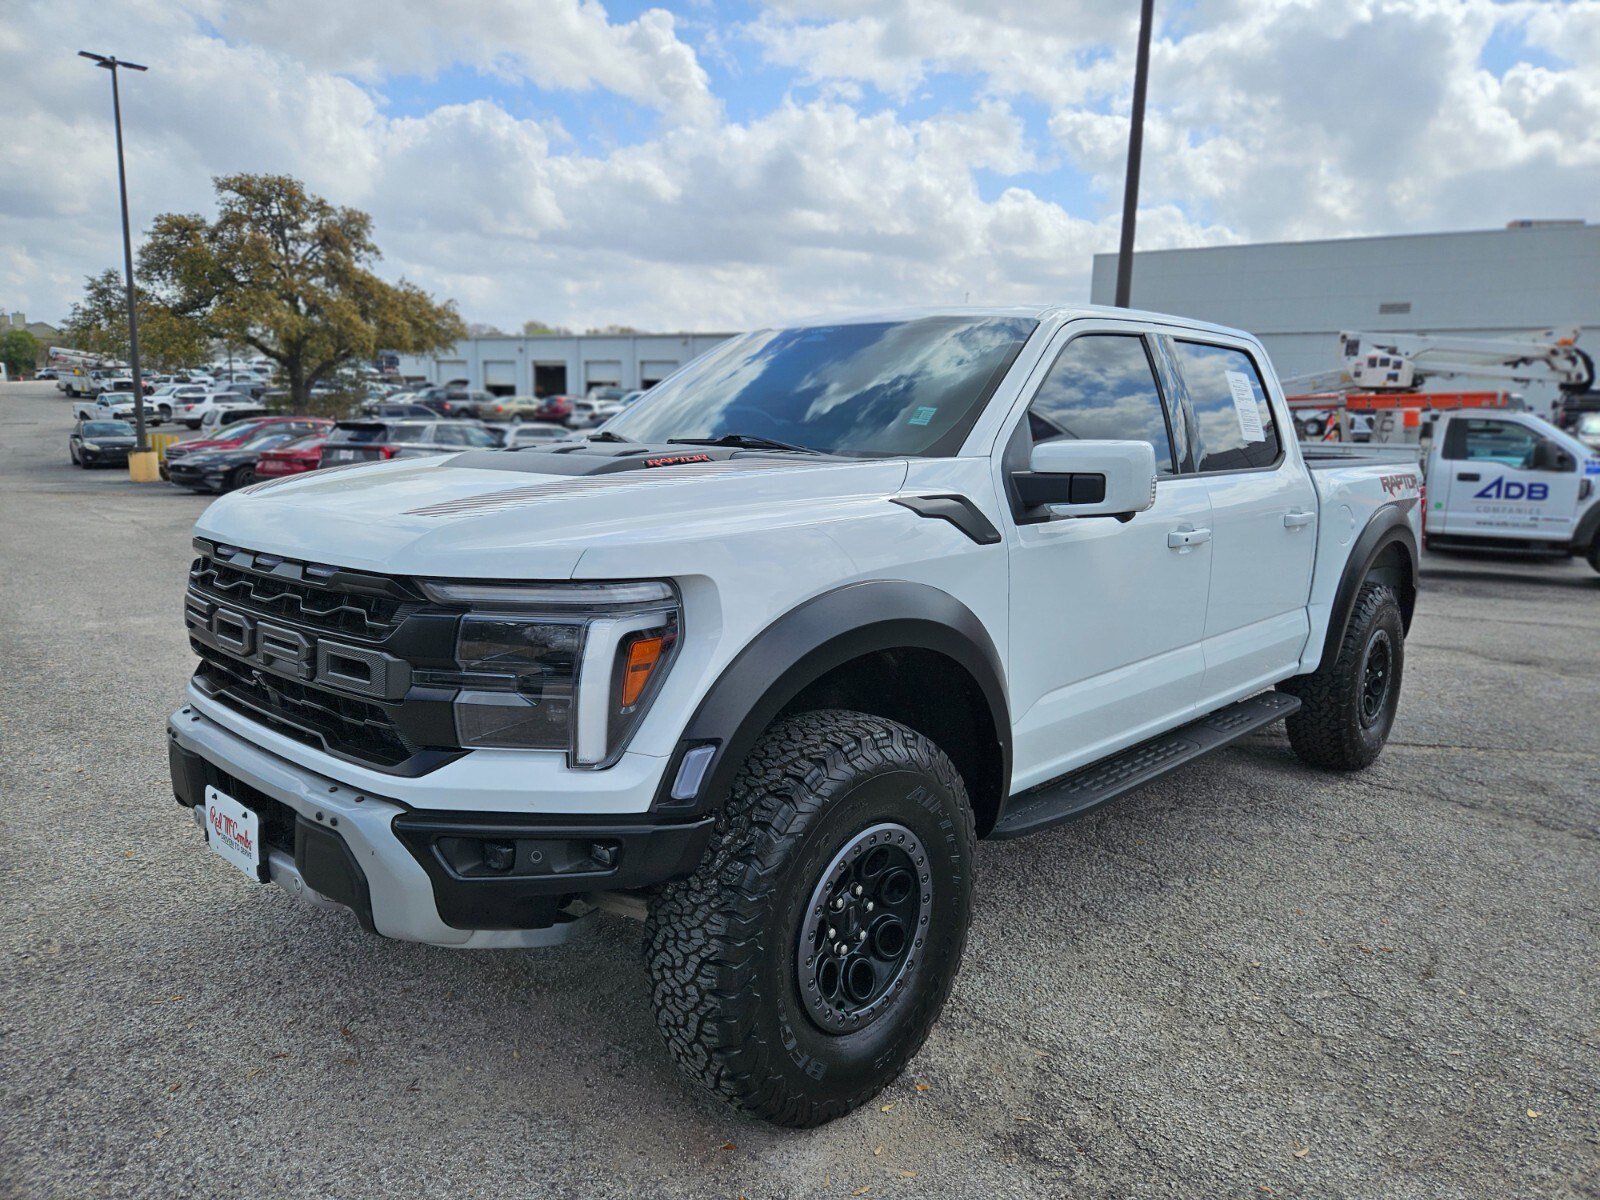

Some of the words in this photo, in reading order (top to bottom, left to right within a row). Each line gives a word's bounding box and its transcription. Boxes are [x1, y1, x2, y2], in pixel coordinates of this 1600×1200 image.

[642, 453, 713, 468] RAPTOR
[1379, 473, 1420, 498] RAPTOR
[1473, 476, 1549, 500] ADB
[185, 590, 412, 702] FORD
